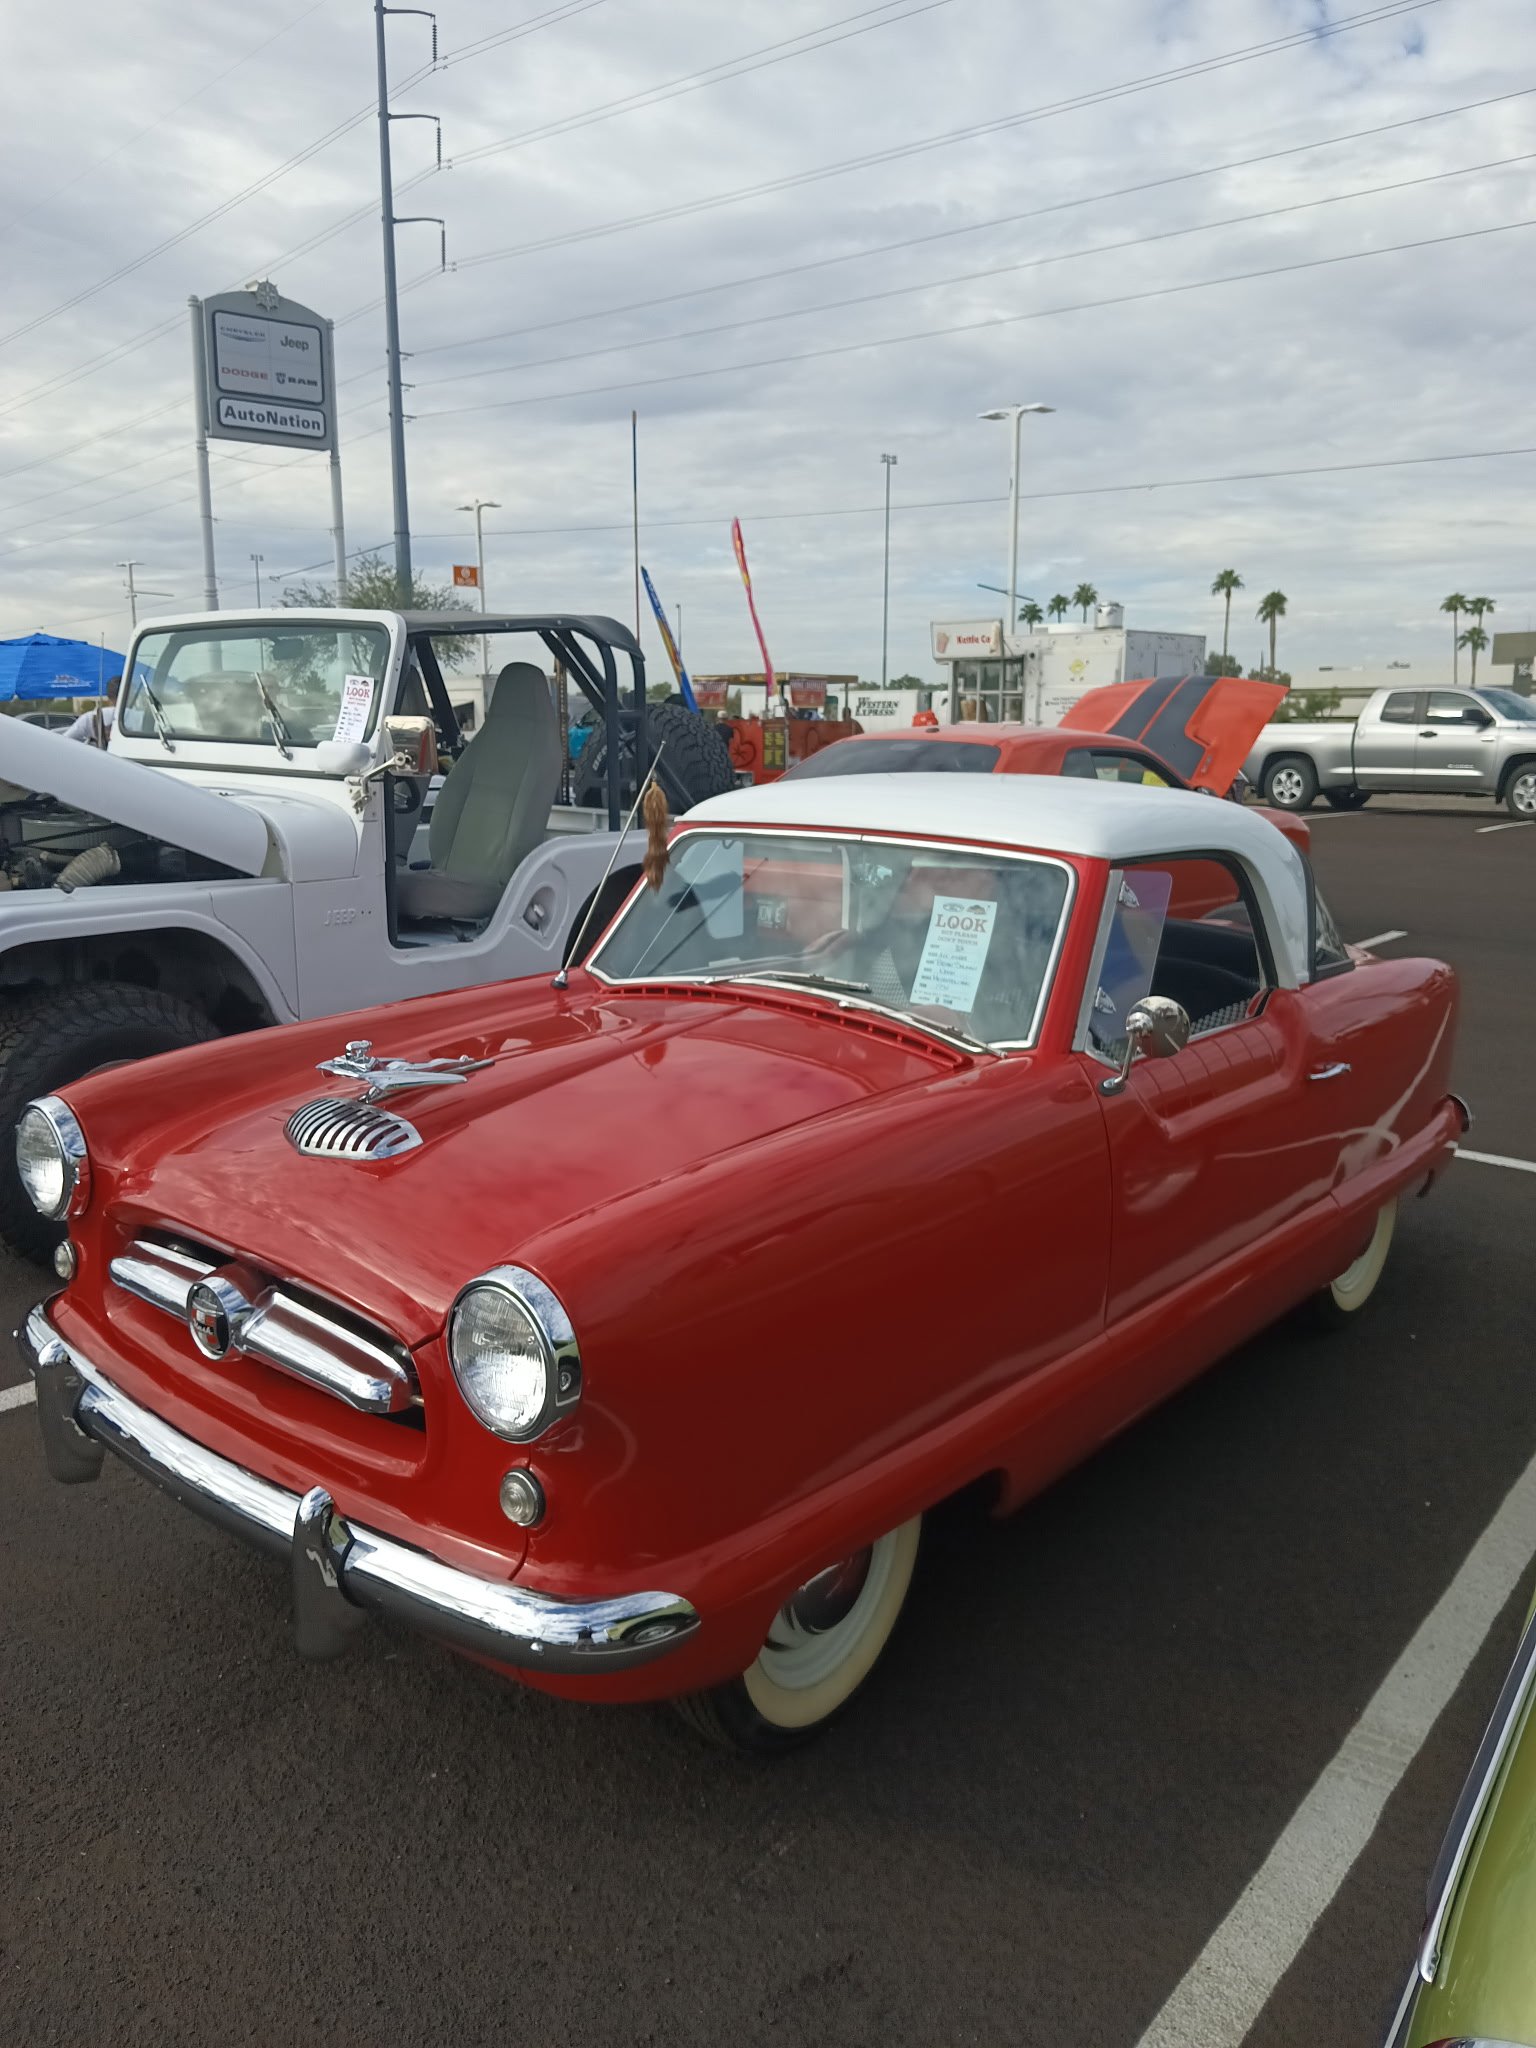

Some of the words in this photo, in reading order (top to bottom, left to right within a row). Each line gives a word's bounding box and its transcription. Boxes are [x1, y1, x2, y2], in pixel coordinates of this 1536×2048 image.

[280, 336, 309, 351] Jeep
[221, 366, 269, 380] DODGE
[288, 377, 318, 386] RAM
[224, 405, 321, 431] AutoNation
[346, 686, 370, 698] LOOK
[857, 697, 899, 708] WESTERN
[855, 706, 895, 716] EXPRESS
[324, 908, 357, 926] JEEP
[935, 913, 988, 933] LOOK
